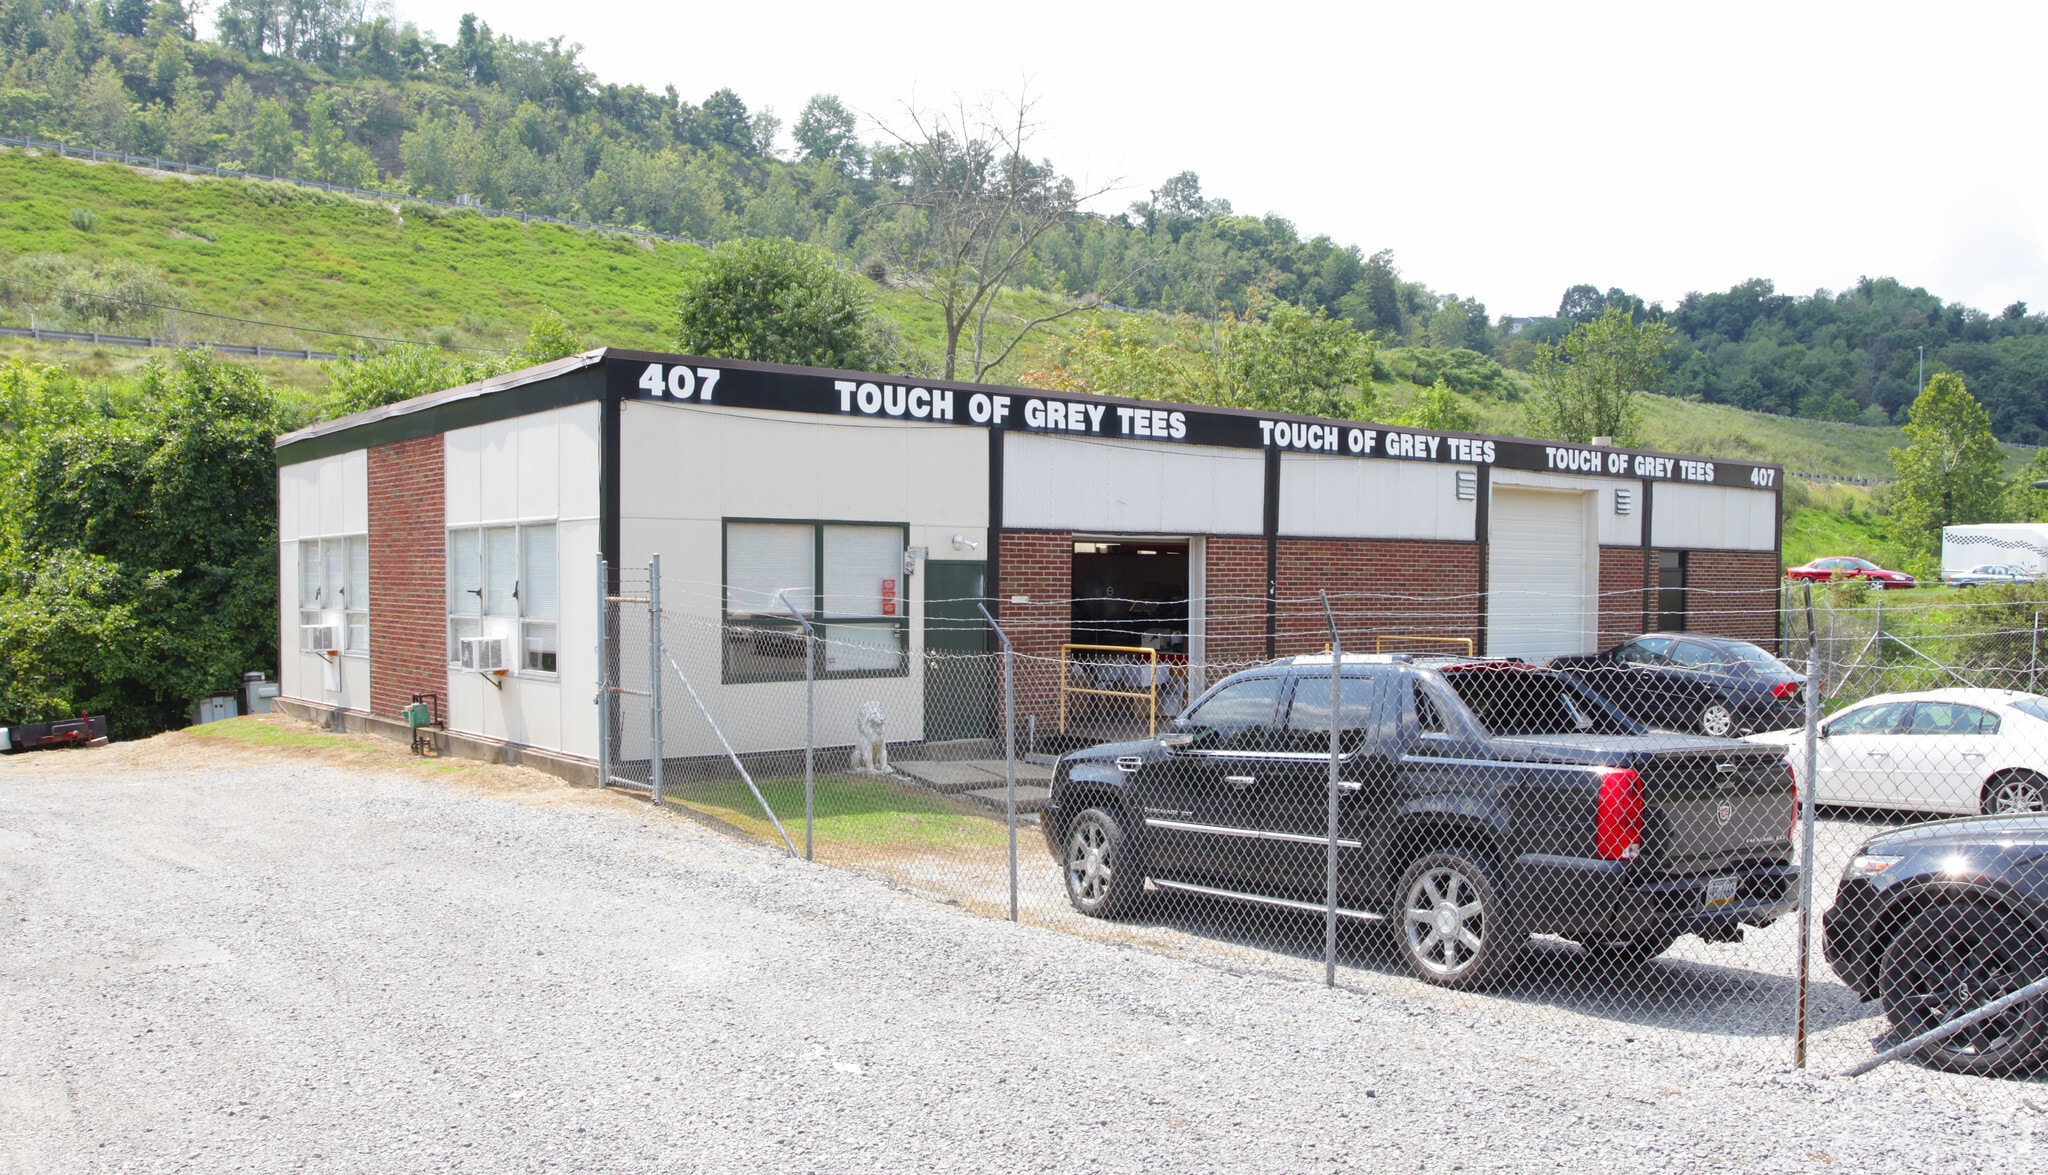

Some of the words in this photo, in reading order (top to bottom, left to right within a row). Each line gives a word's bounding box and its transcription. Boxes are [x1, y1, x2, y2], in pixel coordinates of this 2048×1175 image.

[638, 363, 720, 401] 407
[834, 380, 954, 420] TOUCH
[968, 393, 1011, 424] OF
[1024, 398, 1106, 433] GREY
[1116, 407, 1187, 439] TEES
[1259, 420, 1339, 451] TOUCH
[1348, 428, 1377, 454] OF
[1385, 432, 1441, 462] GREY
[1447, 437, 1496, 463] TEES
[1545, 446, 1602, 472] TOUCH
[1608, 453, 1629, 474] OF
[1634, 455, 1675, 478] GREY
[1679, 460, 1715, 482] TEES
[1750, 467, 1775, 487] 407
